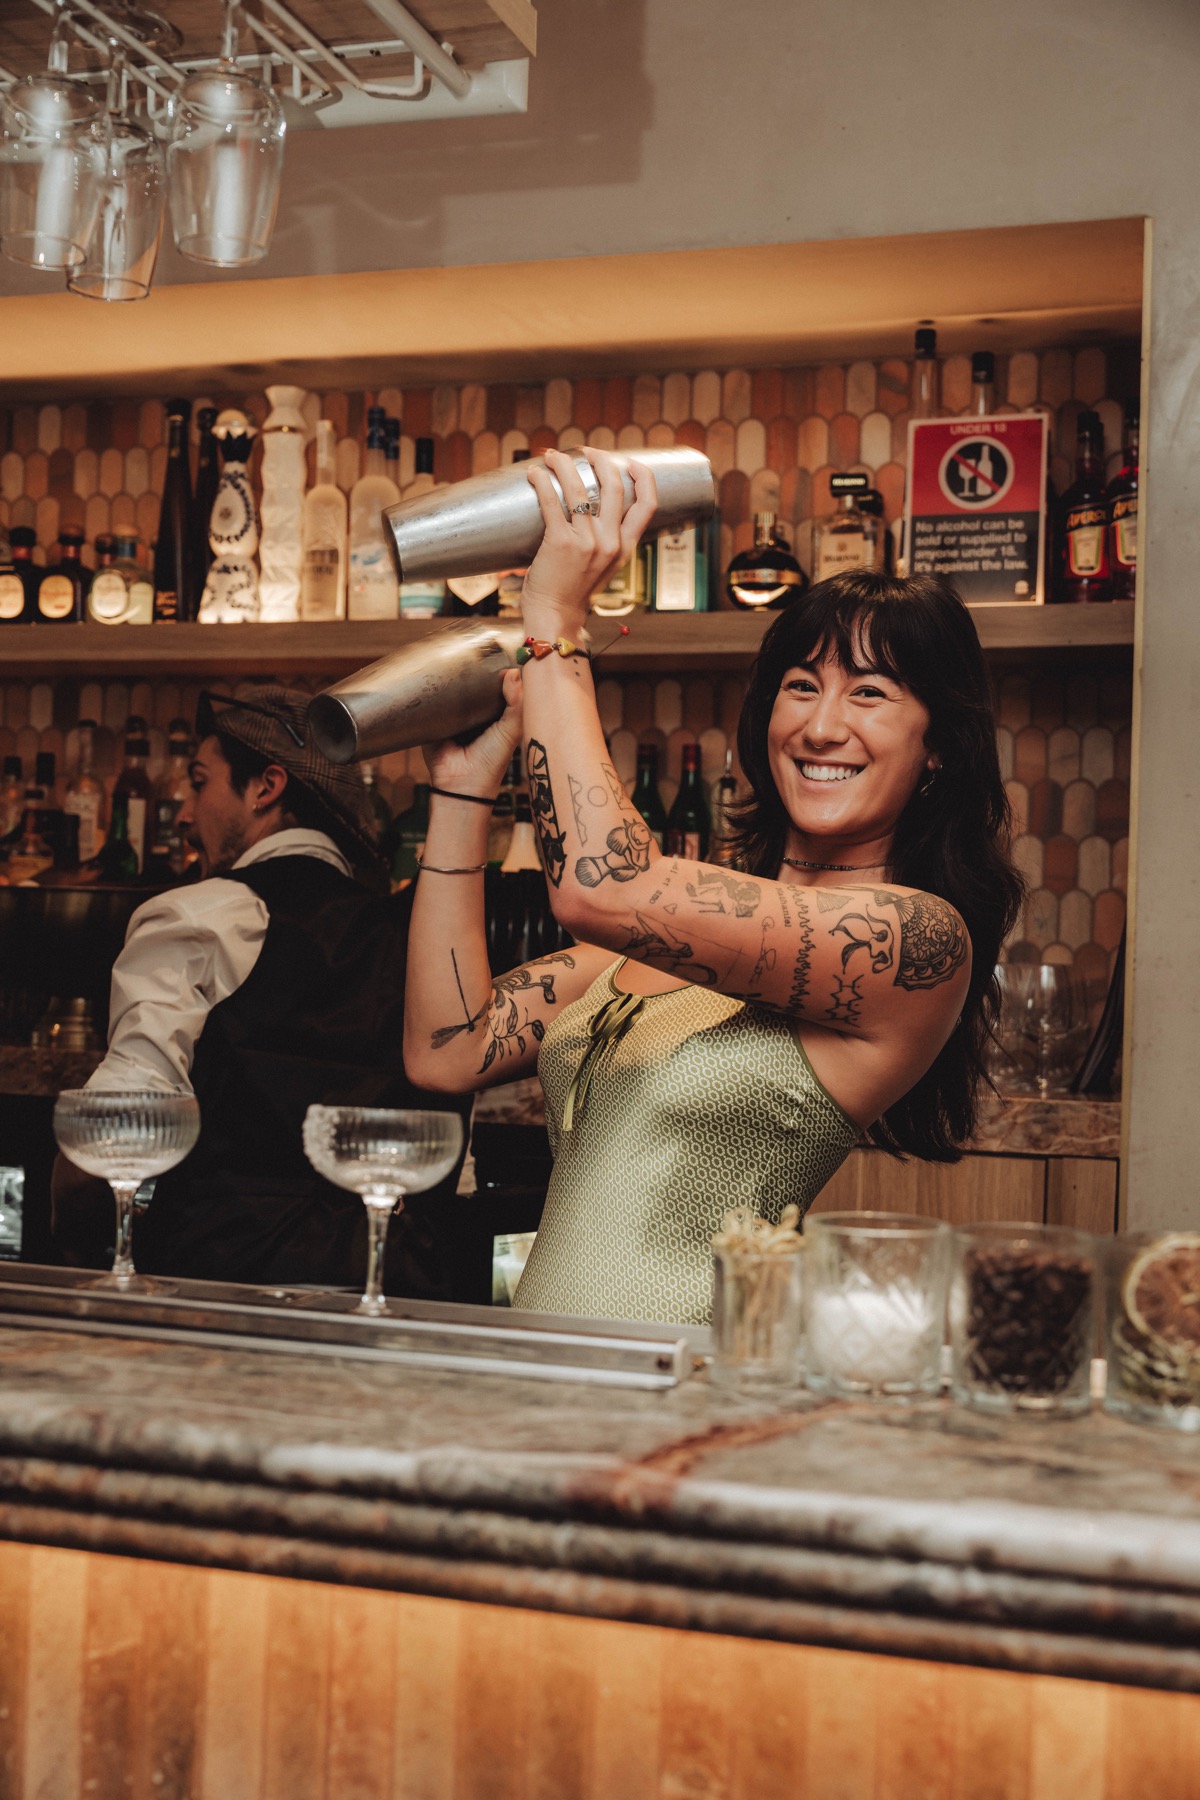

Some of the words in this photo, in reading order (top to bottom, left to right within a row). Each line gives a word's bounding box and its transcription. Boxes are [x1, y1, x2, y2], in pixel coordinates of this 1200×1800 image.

[950, 423, 990, 435] UNDER
[994, 422, 1007, 433] 18
[916, 521, 933, 532] No
[936, 520, 980, 532] alcohol
[982, 520, 1005, 531] can
[1007, 518, 1024, 529] be
[915, 534, 942, 546] sold
[944, 535, 957, 545] or
[960, 532, 1012, 546] supplied
[1014, 532, 1027, 543] to
[915, 549, 959, 561] anyone
[961, 546, 997, 558] under
[914, 561, 932, 572] It's
[934, 561, 979, 574] against
[981, 559, 1001, 571] the
[1004, 559, 1028, 570] law.
